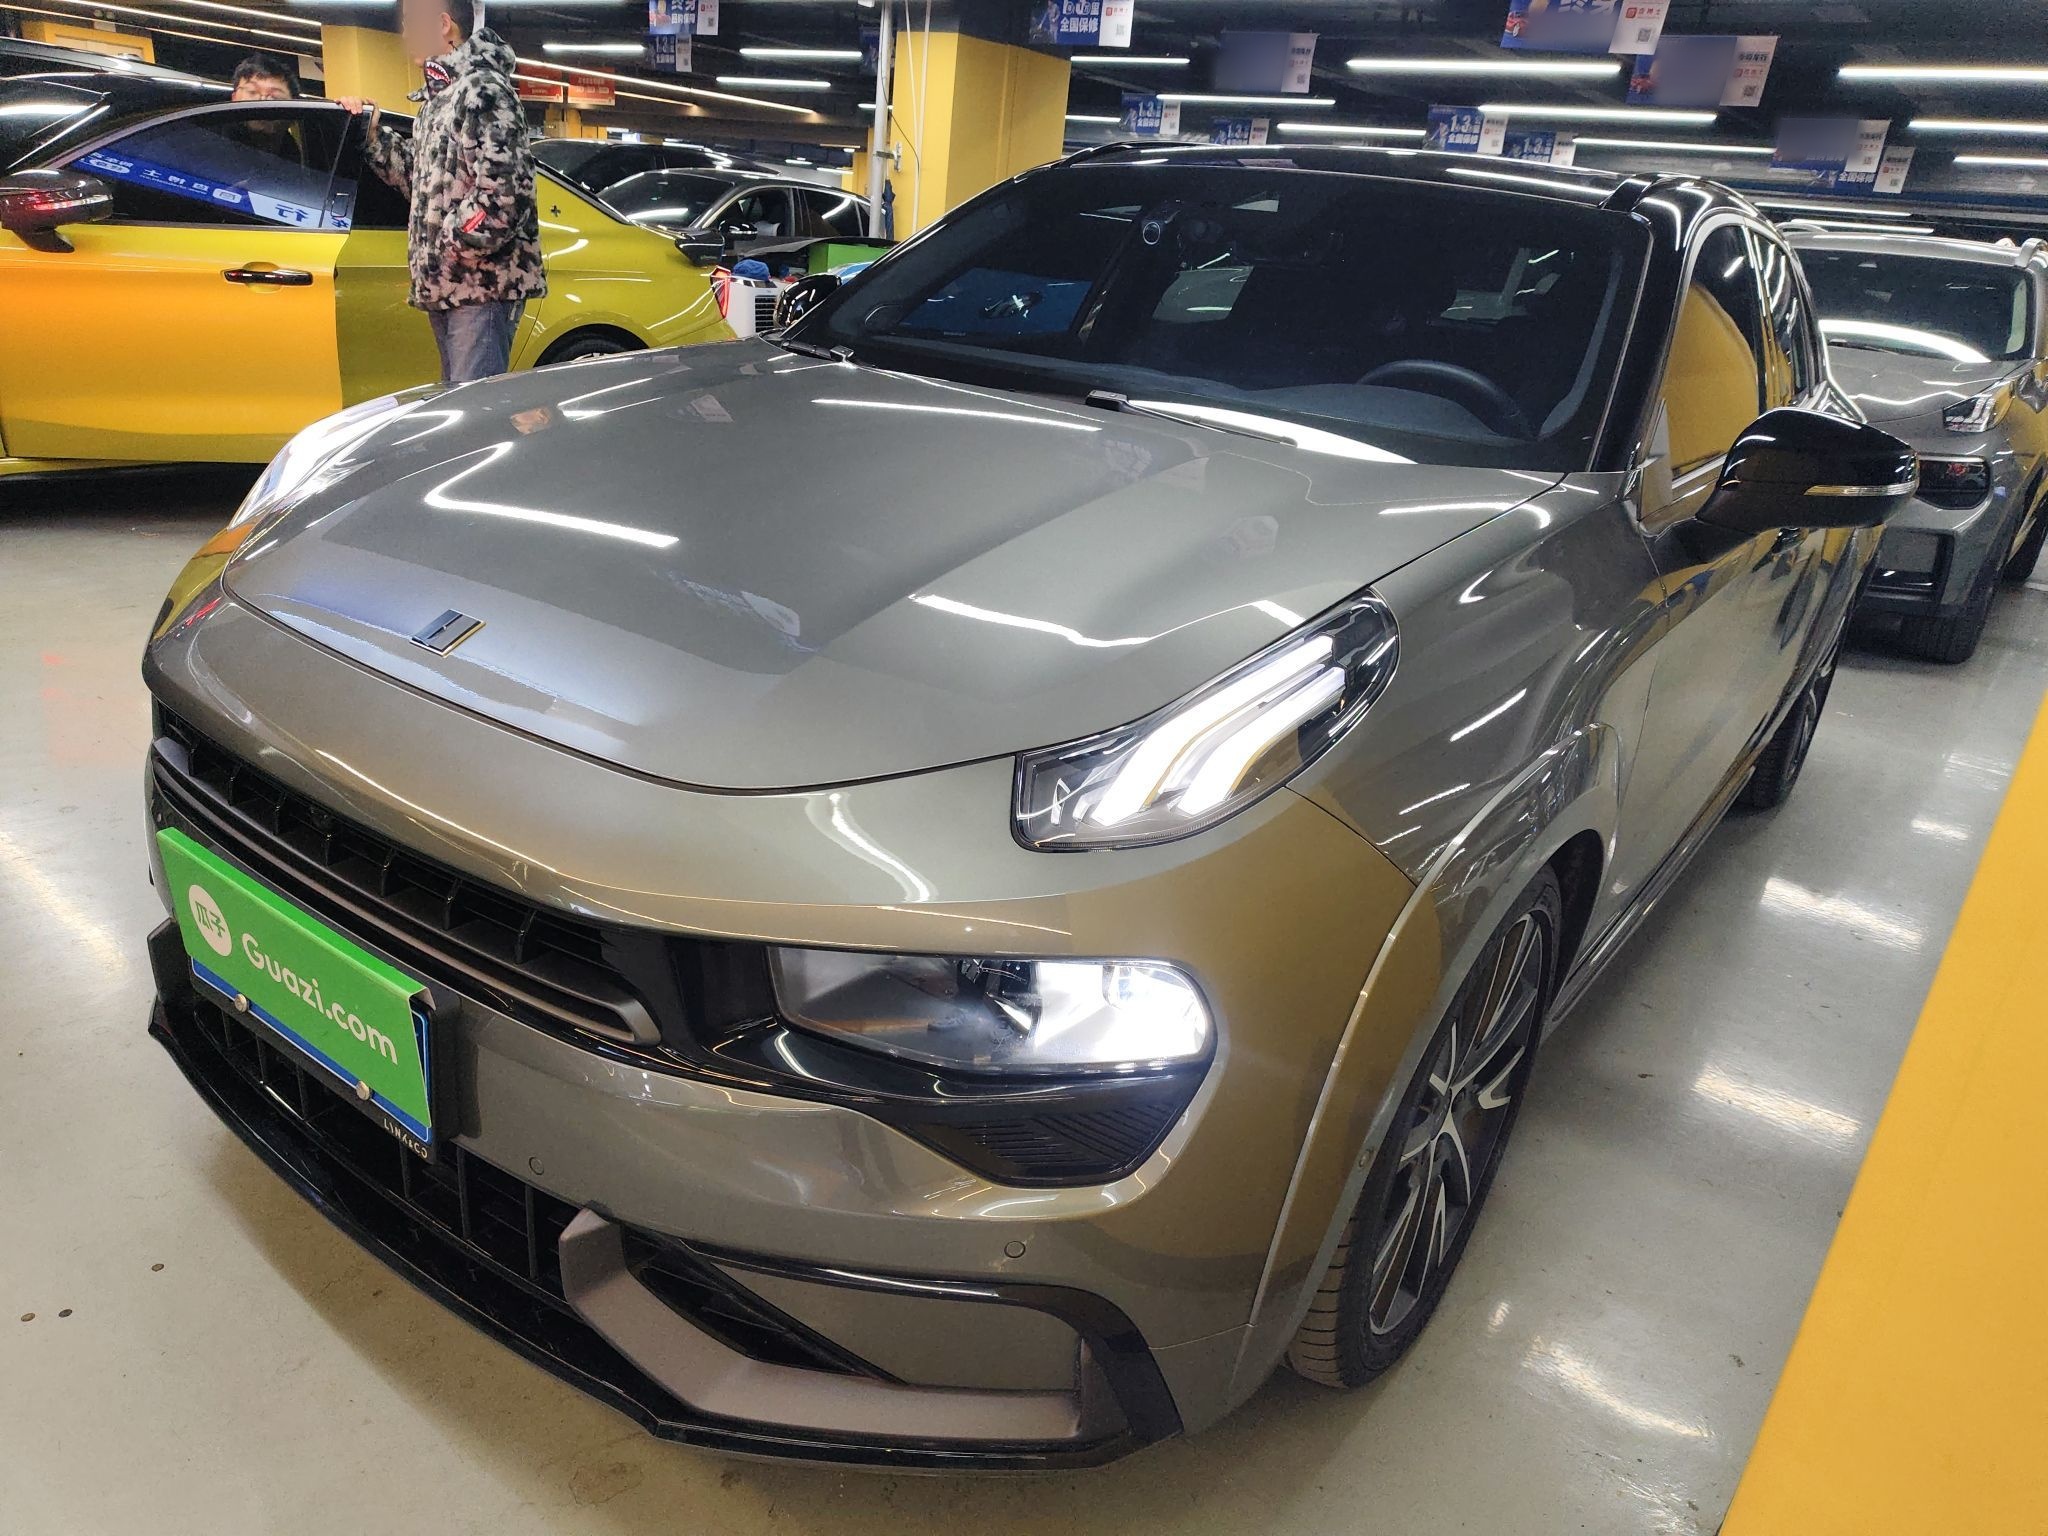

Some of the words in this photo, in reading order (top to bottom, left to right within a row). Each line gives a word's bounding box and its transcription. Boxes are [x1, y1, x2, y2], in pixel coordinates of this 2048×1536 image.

[1060, 17, 1099, 33] 全国保修
[194, 900, 226, 939] 瓜子
[242, 933, 398, 1065] Guazi.com
